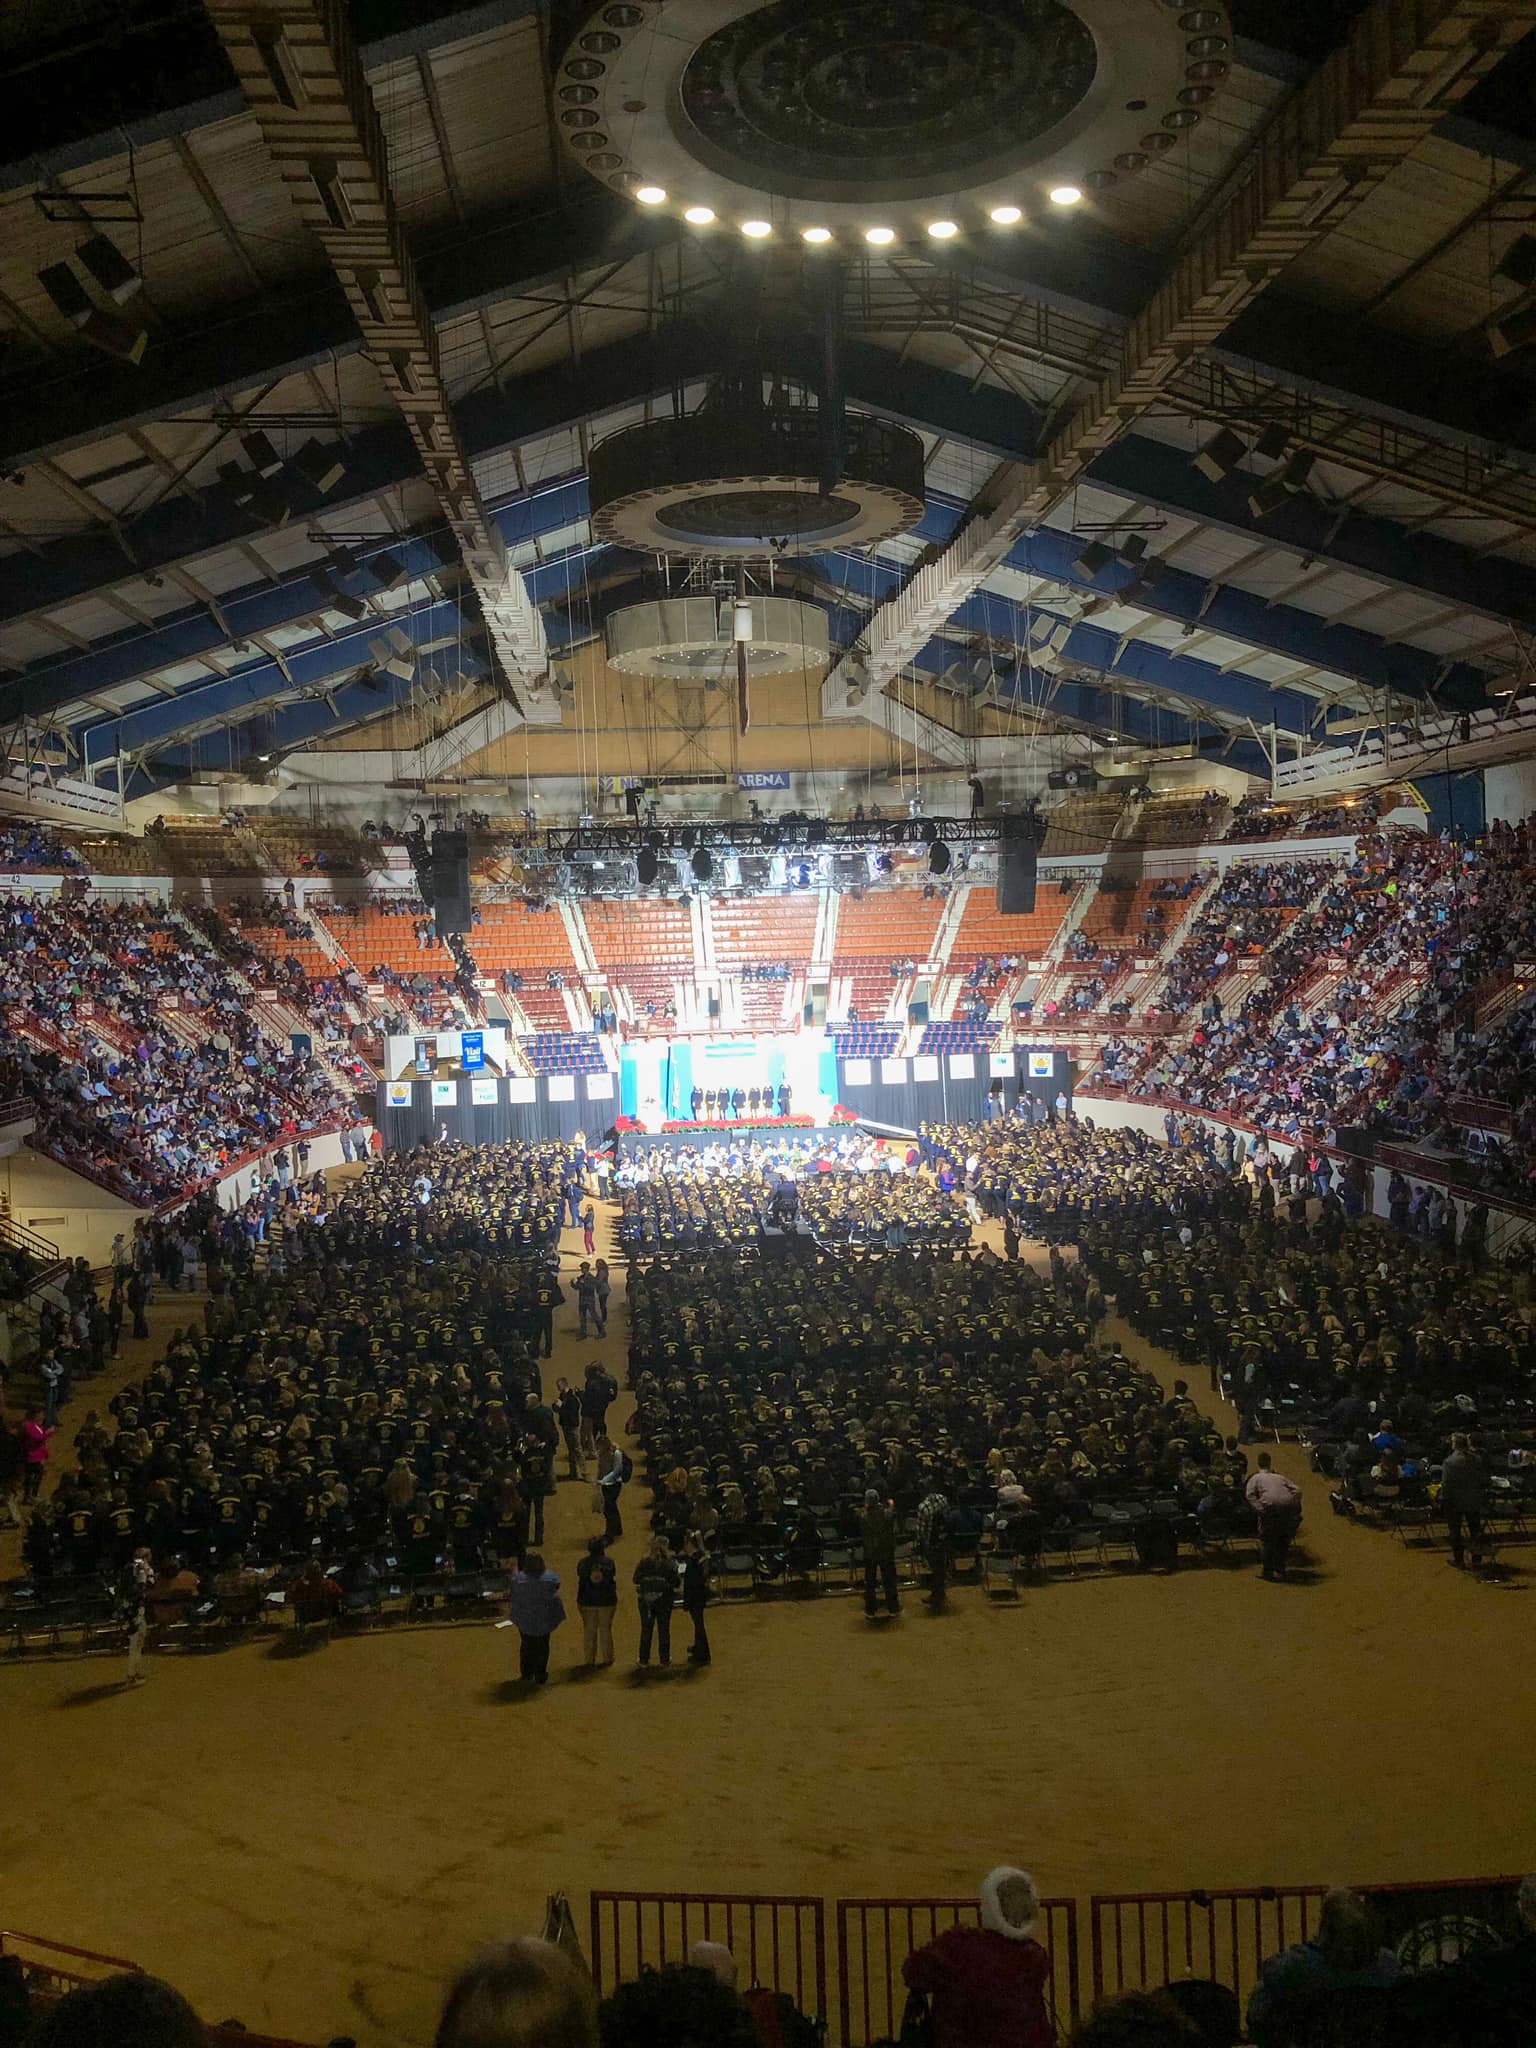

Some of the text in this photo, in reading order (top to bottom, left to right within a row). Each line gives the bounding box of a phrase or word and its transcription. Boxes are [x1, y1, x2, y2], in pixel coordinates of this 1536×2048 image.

[738, 773, 786, 787] ARENA
[11, 875, 20, 884] 42
[479, 980, 487, 988] 12
